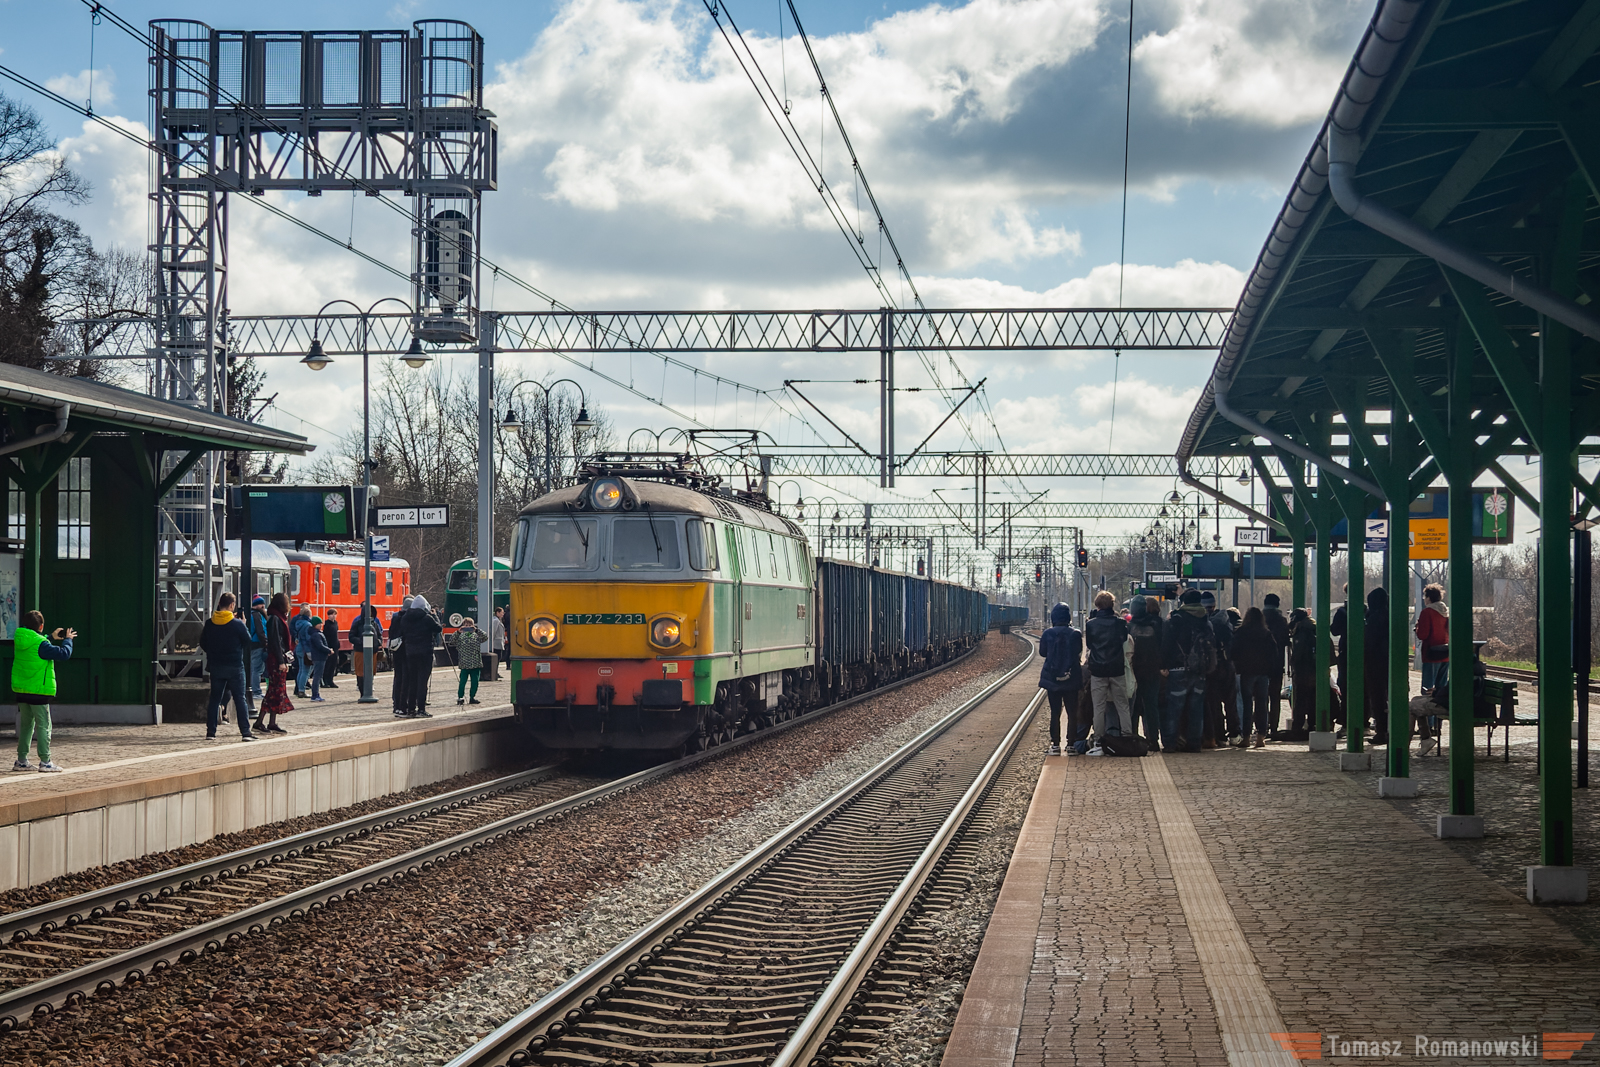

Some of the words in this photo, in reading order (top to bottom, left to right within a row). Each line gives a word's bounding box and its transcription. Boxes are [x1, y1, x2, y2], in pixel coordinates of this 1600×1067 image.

[382, 513, 405, 523] peron
[409, 511, 415, 520] 2
[422, 511, 435, 520] tor
[438, 510, 442, 519] 1
[1240, 532, 1251, 540] tor
[1253, 532, 1258, 540] 2
[566, 614, 643, 624] ET22-233
